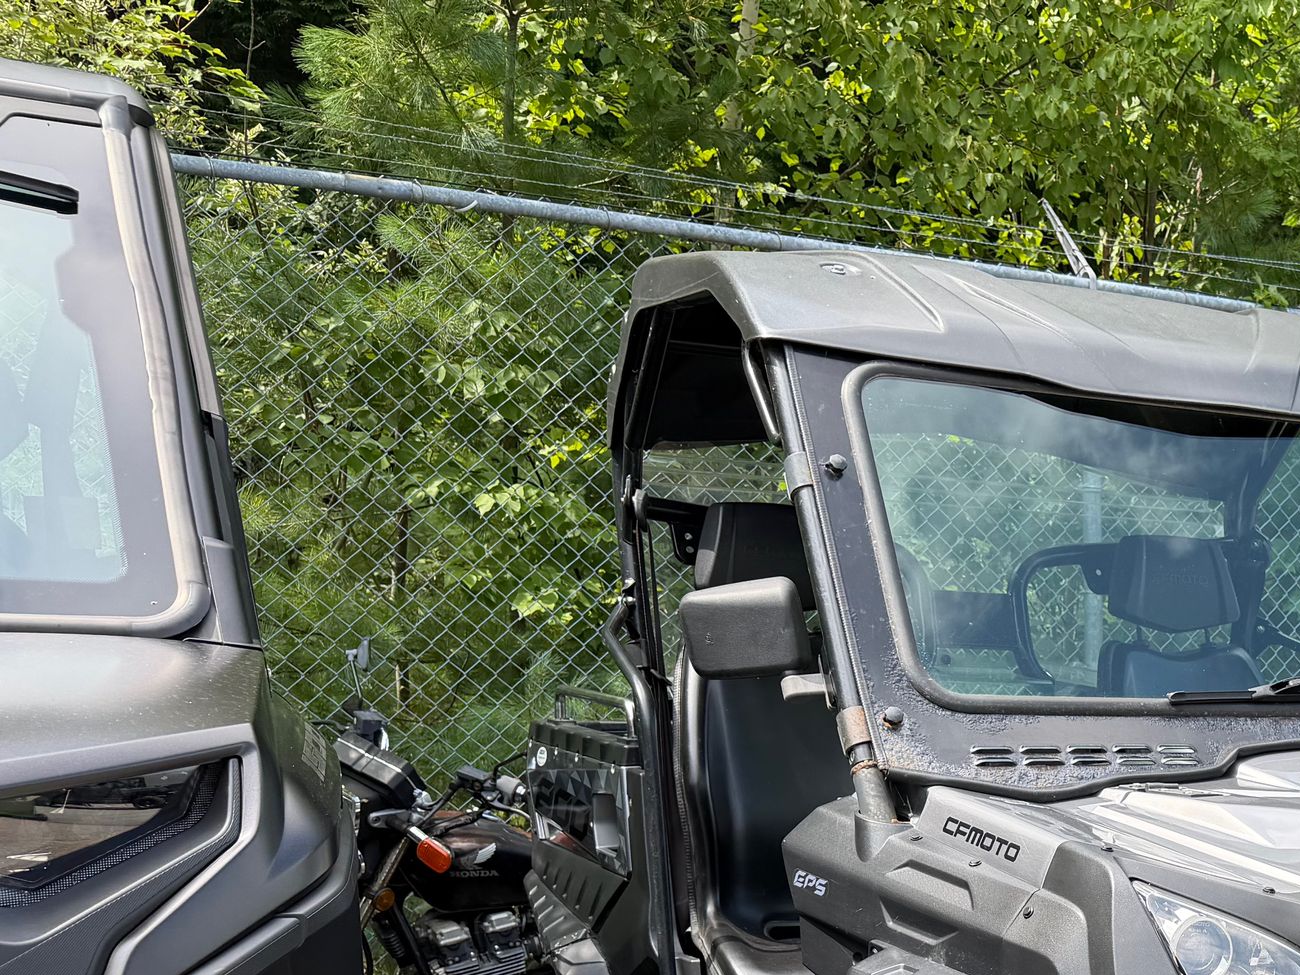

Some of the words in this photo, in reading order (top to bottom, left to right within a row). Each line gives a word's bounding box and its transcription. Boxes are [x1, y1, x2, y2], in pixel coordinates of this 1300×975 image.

[943, 816, 1021, 862] CFMOTO
[450, 870, 499, 878] HONDA
[793, 869, 828, 897] EPS
